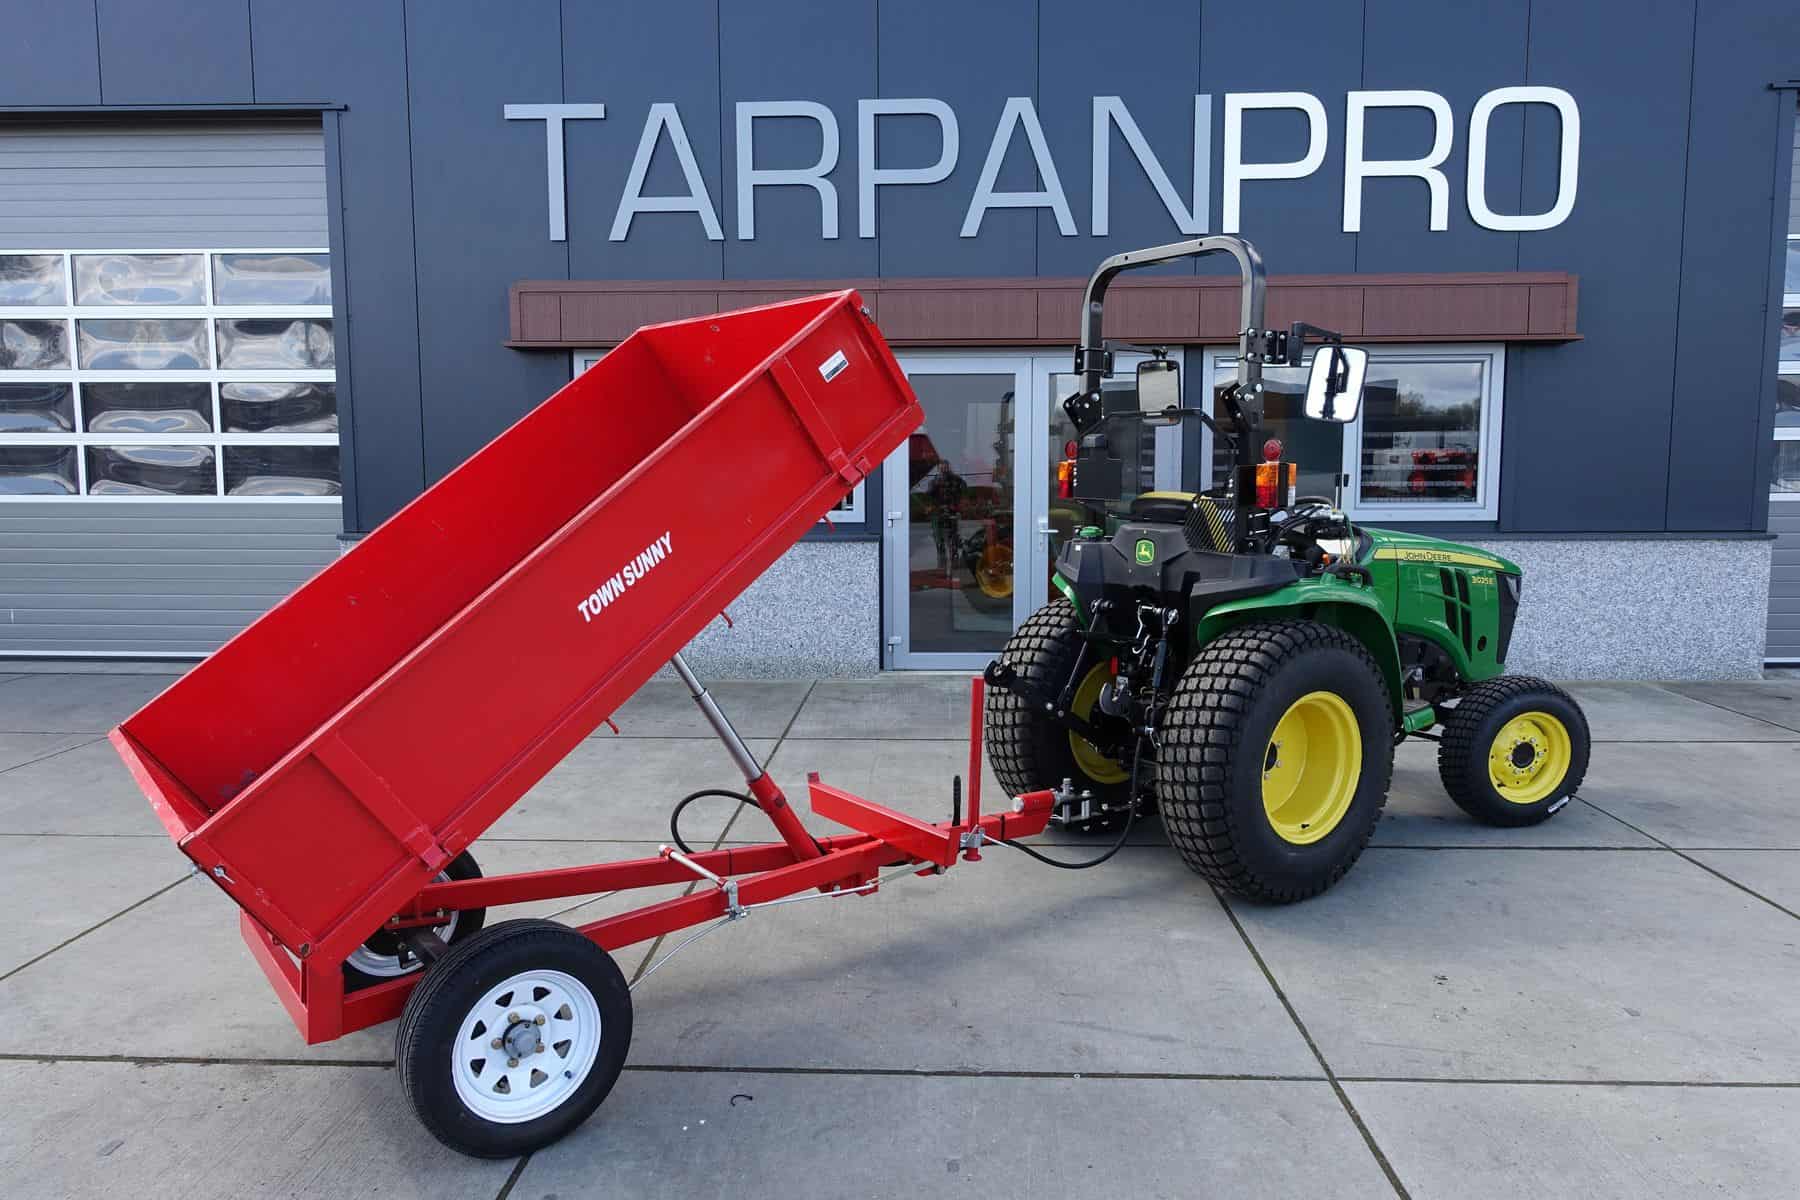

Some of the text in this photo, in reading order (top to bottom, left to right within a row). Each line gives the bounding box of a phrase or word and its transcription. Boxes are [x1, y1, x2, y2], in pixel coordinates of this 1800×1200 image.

[504, 86, 1580, 241] TARPANPRO
[577, 530, 673, 623] TOWN SUNNY
